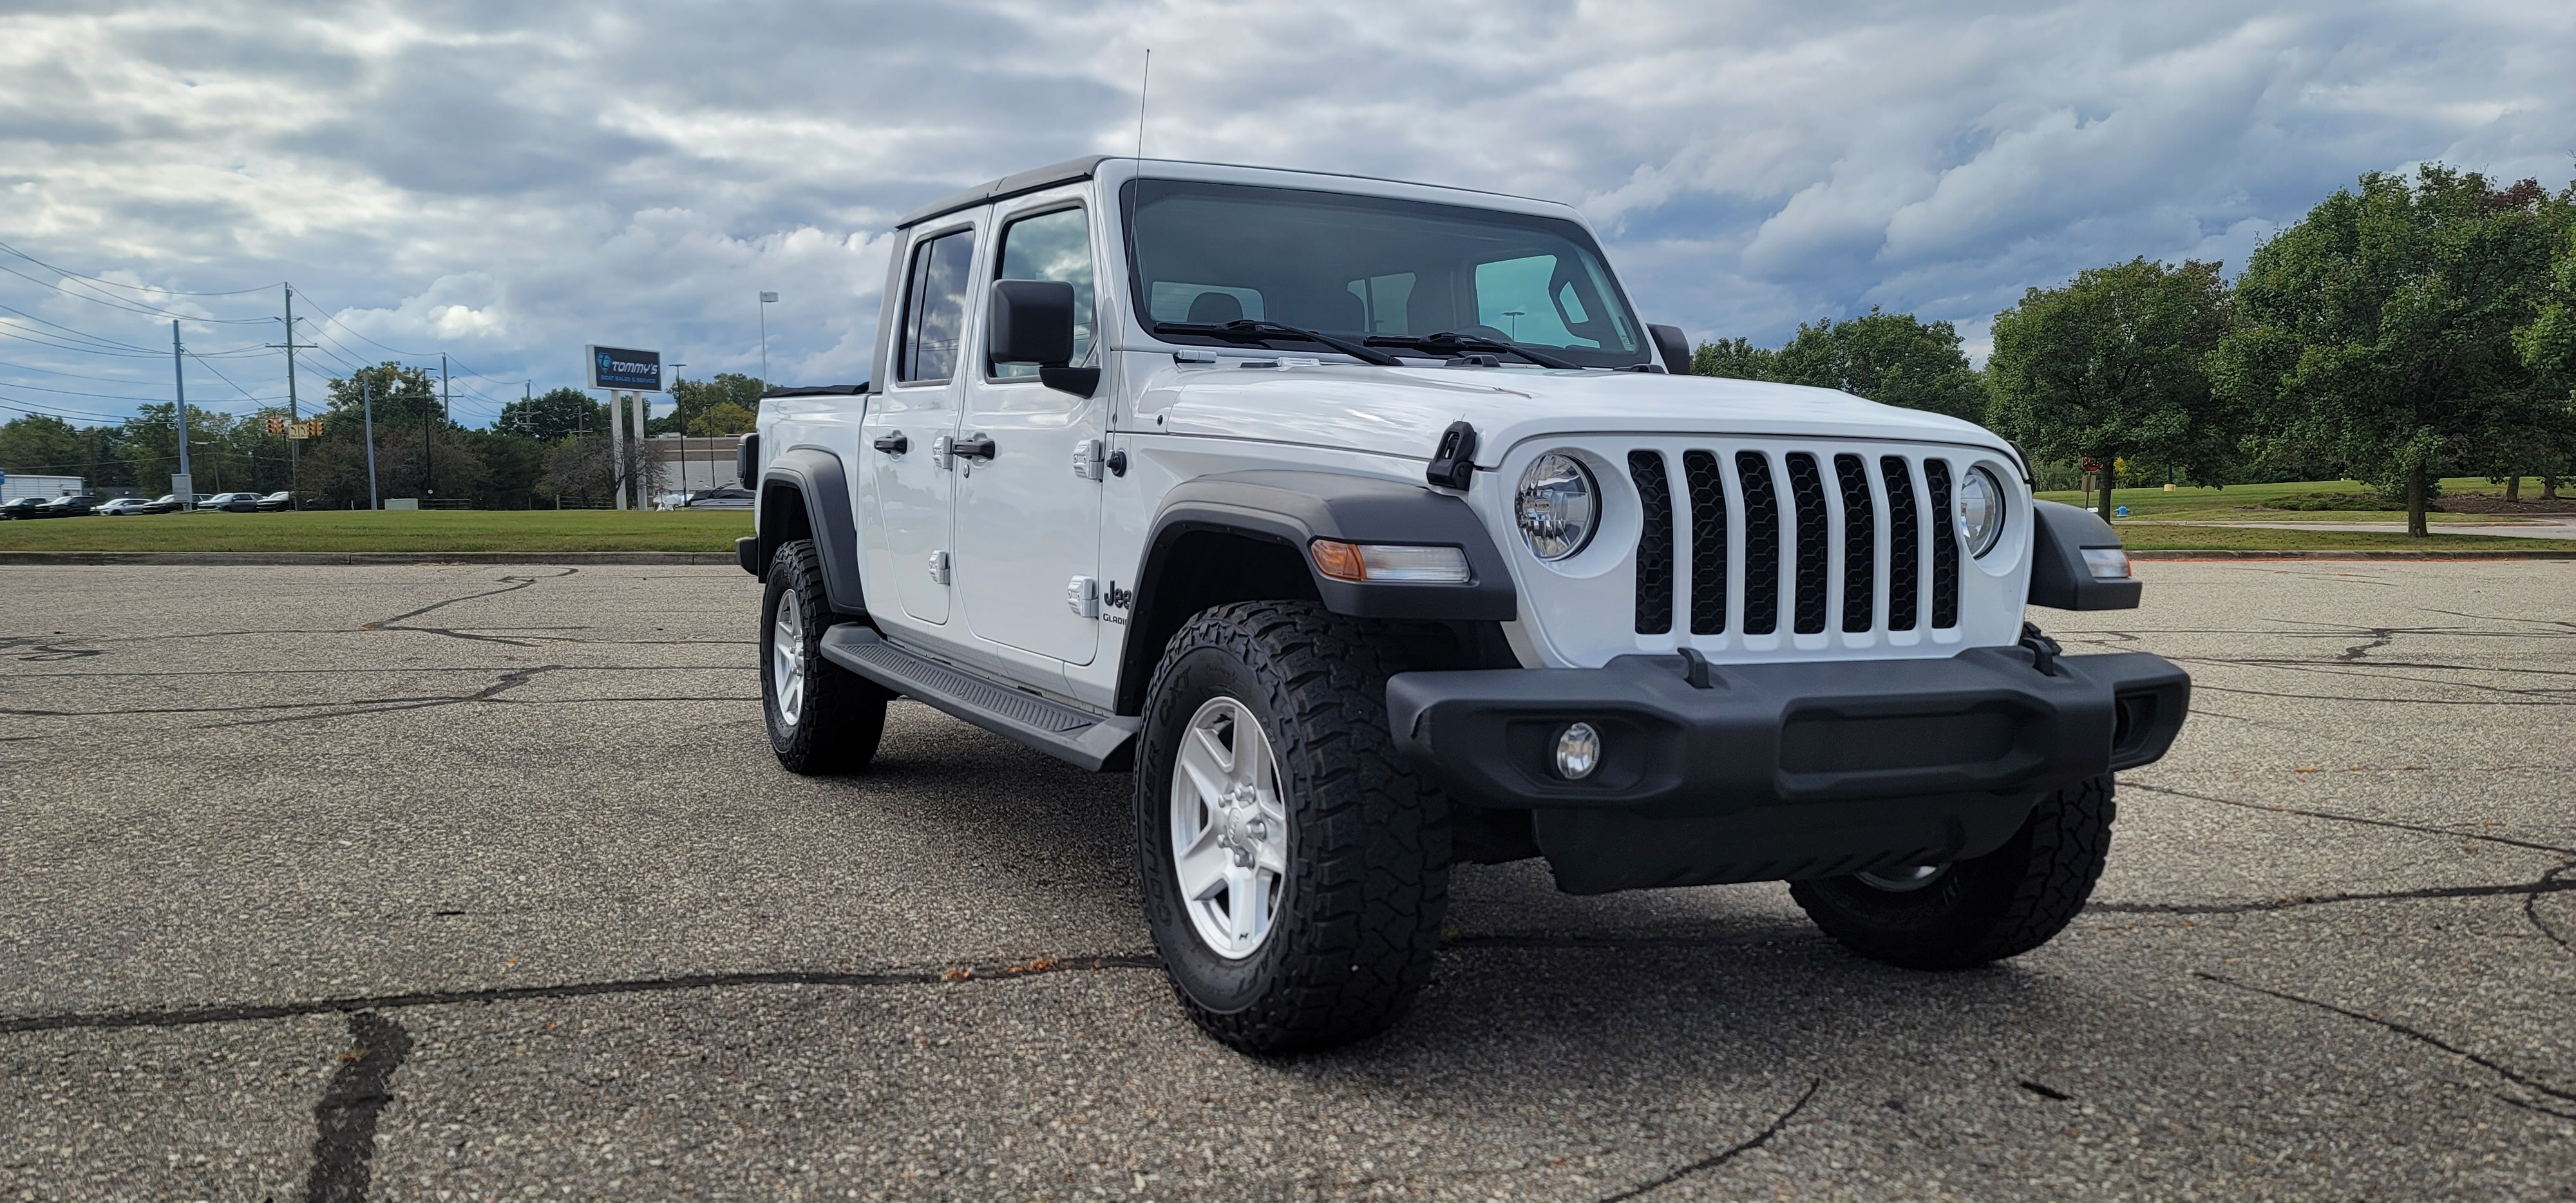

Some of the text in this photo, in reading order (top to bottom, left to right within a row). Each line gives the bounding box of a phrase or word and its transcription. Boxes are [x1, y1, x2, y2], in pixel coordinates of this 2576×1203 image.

[612, 361, 658, 375] TOMMY'S
[1104, 580, 1132, 611] Jee
[1103, 613, 1127, 625] GLADI
